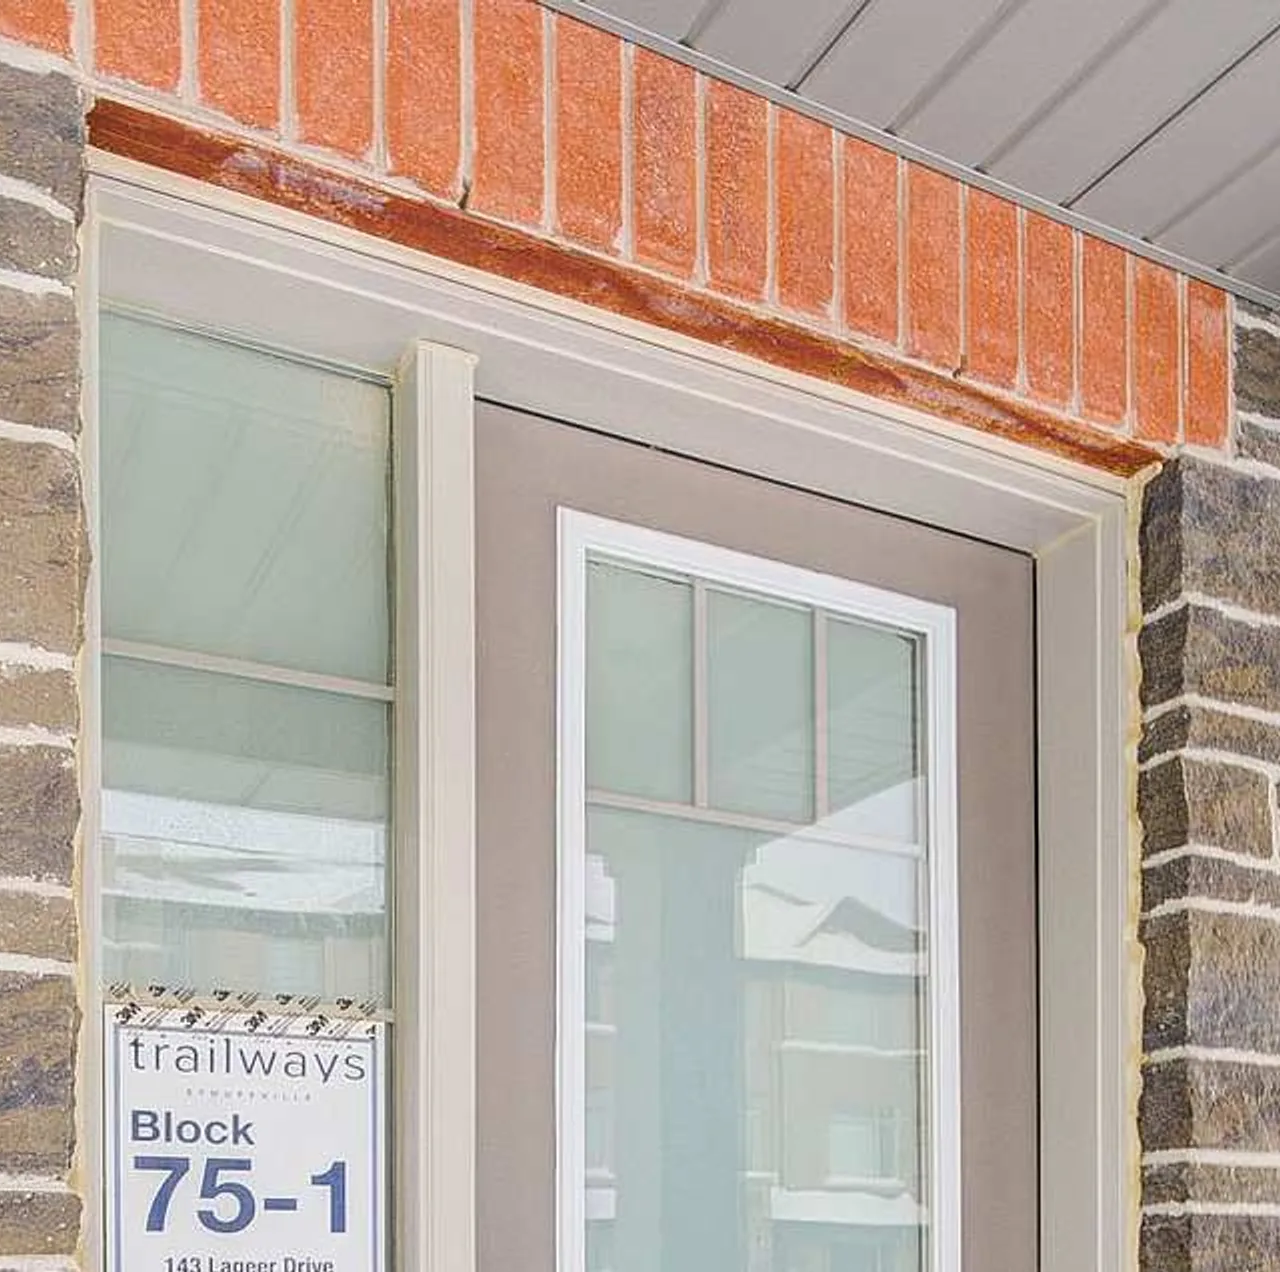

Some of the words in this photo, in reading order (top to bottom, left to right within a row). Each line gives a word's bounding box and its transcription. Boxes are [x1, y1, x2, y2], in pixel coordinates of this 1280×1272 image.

[129, 1037, 366, 1084] trailways
[131, 1110, 255, 1146] Block
[133, 1155, 346, 1234] 75-1
